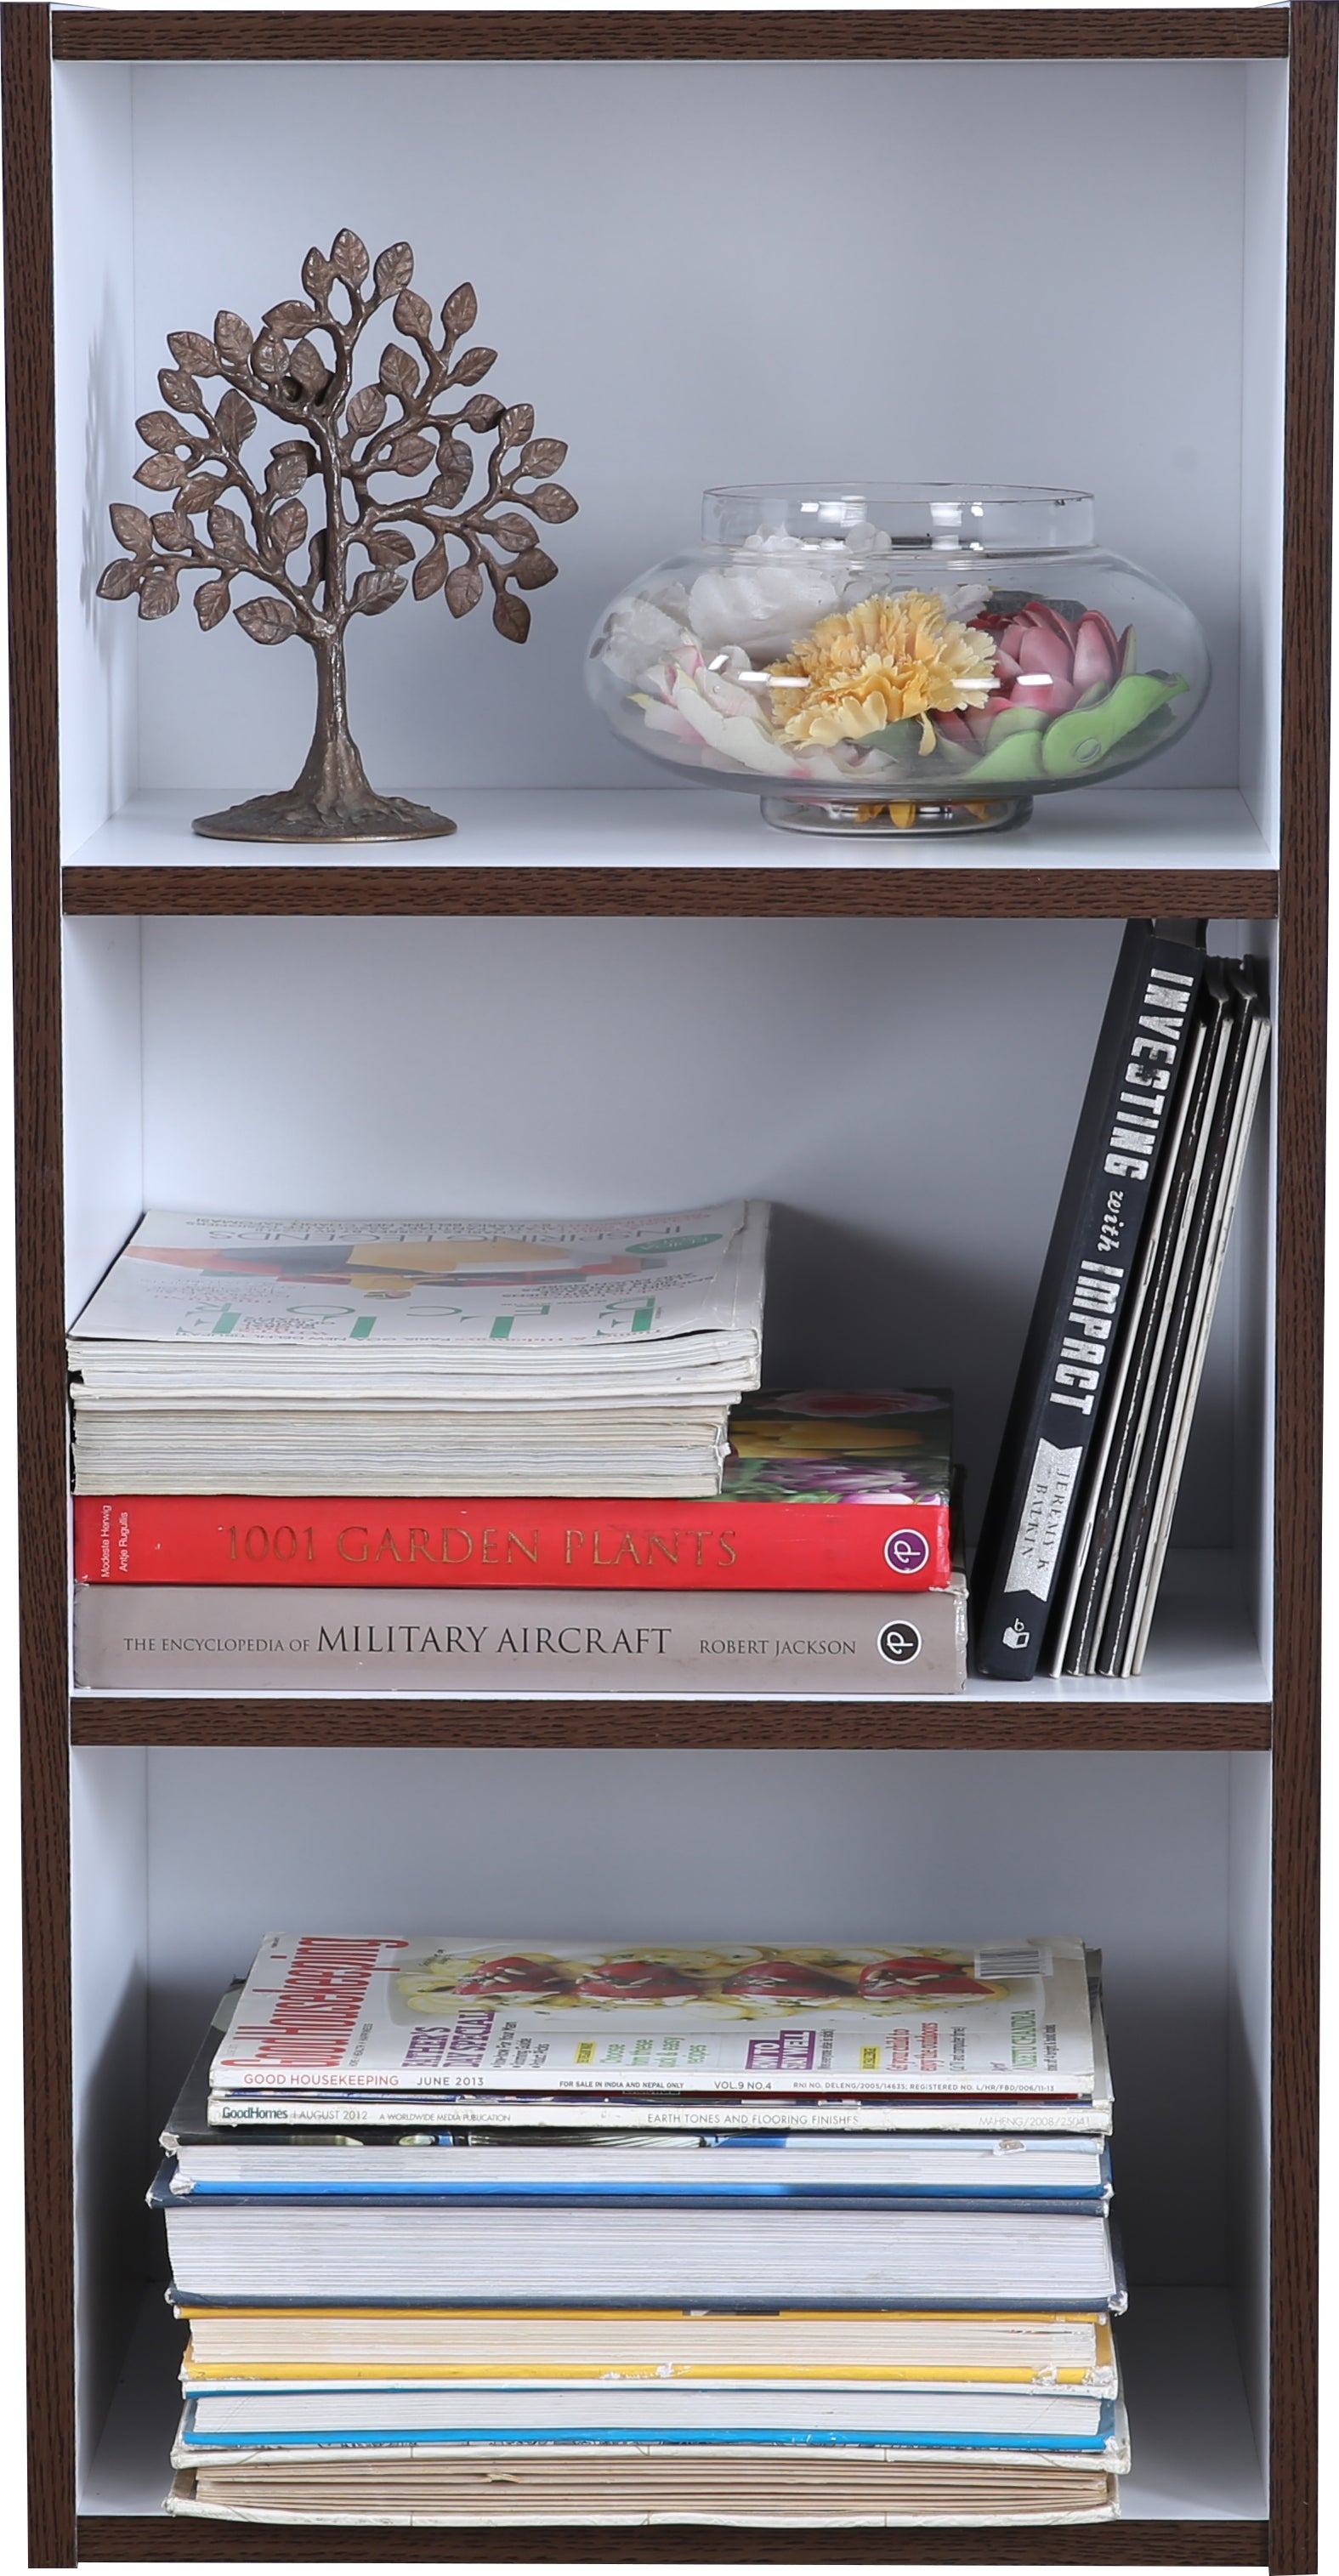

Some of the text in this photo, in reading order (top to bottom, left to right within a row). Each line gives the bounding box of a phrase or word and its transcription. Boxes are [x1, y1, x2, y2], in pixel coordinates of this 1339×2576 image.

[1049, 967, 1194, 1416] INVESTING with IMPACT
[1019, 1484, 1048, 1558] BALKIN
[1037, 1467, 1070, 1571] JEREMY K
[100, 1505, 112, 1578] Modeste Herwig
[118, 1512, 130, 1572] Antje Rugullis
[228, 1525, 738, 1567] 1001 GARDEN PLANTS
[123, 1625, 856, 1657] THE ENCYCLOPEDIA OF MILITARY AIRCRAFT ROBERT JACKSON
[444, 2010, 496, 2068] DAY SPECIAL!
[1010, 2009, 1037, 2045] CHANDRA
[401, 2026, 451, 2068] FATHER'S
[661, 2037, 685, 2051] easy
[753, 2042, 780, 2054] TO
[782, 2031, 810, 2056] WELL
[885, 2036, 910, 2051] child
[914, 2049, 939, 2059] the
[244, 2074, 484, 2087] GOOD HOUSEKEEPING JUNE 2013
[714, 2081, 744, 2090] VOL.9
[746, 2081, 772, 2091] NO.4
[910, 2083, 958, 2091] REGISTERED
[222, 2107, 288, 2119] GoodHomes
[298, 2109, 340, 2120] AUGUST
[343, 2109, 368, 2121] 2012
[387, 2114, 434, 2122] WORLDWIDE
[436, 2114, 461, 2122] MEDIA
[462, 2114, 511, 2123] PUBLICATION
[648, 2114, 680, 2124] EARTH
[684, 2114, 720, 2124] TONES
[723, 2114, 748, 2125] AND
[752, 2114, 808, 2125] FLOORING
[812, 2115, 859, 2125] FINISHES
